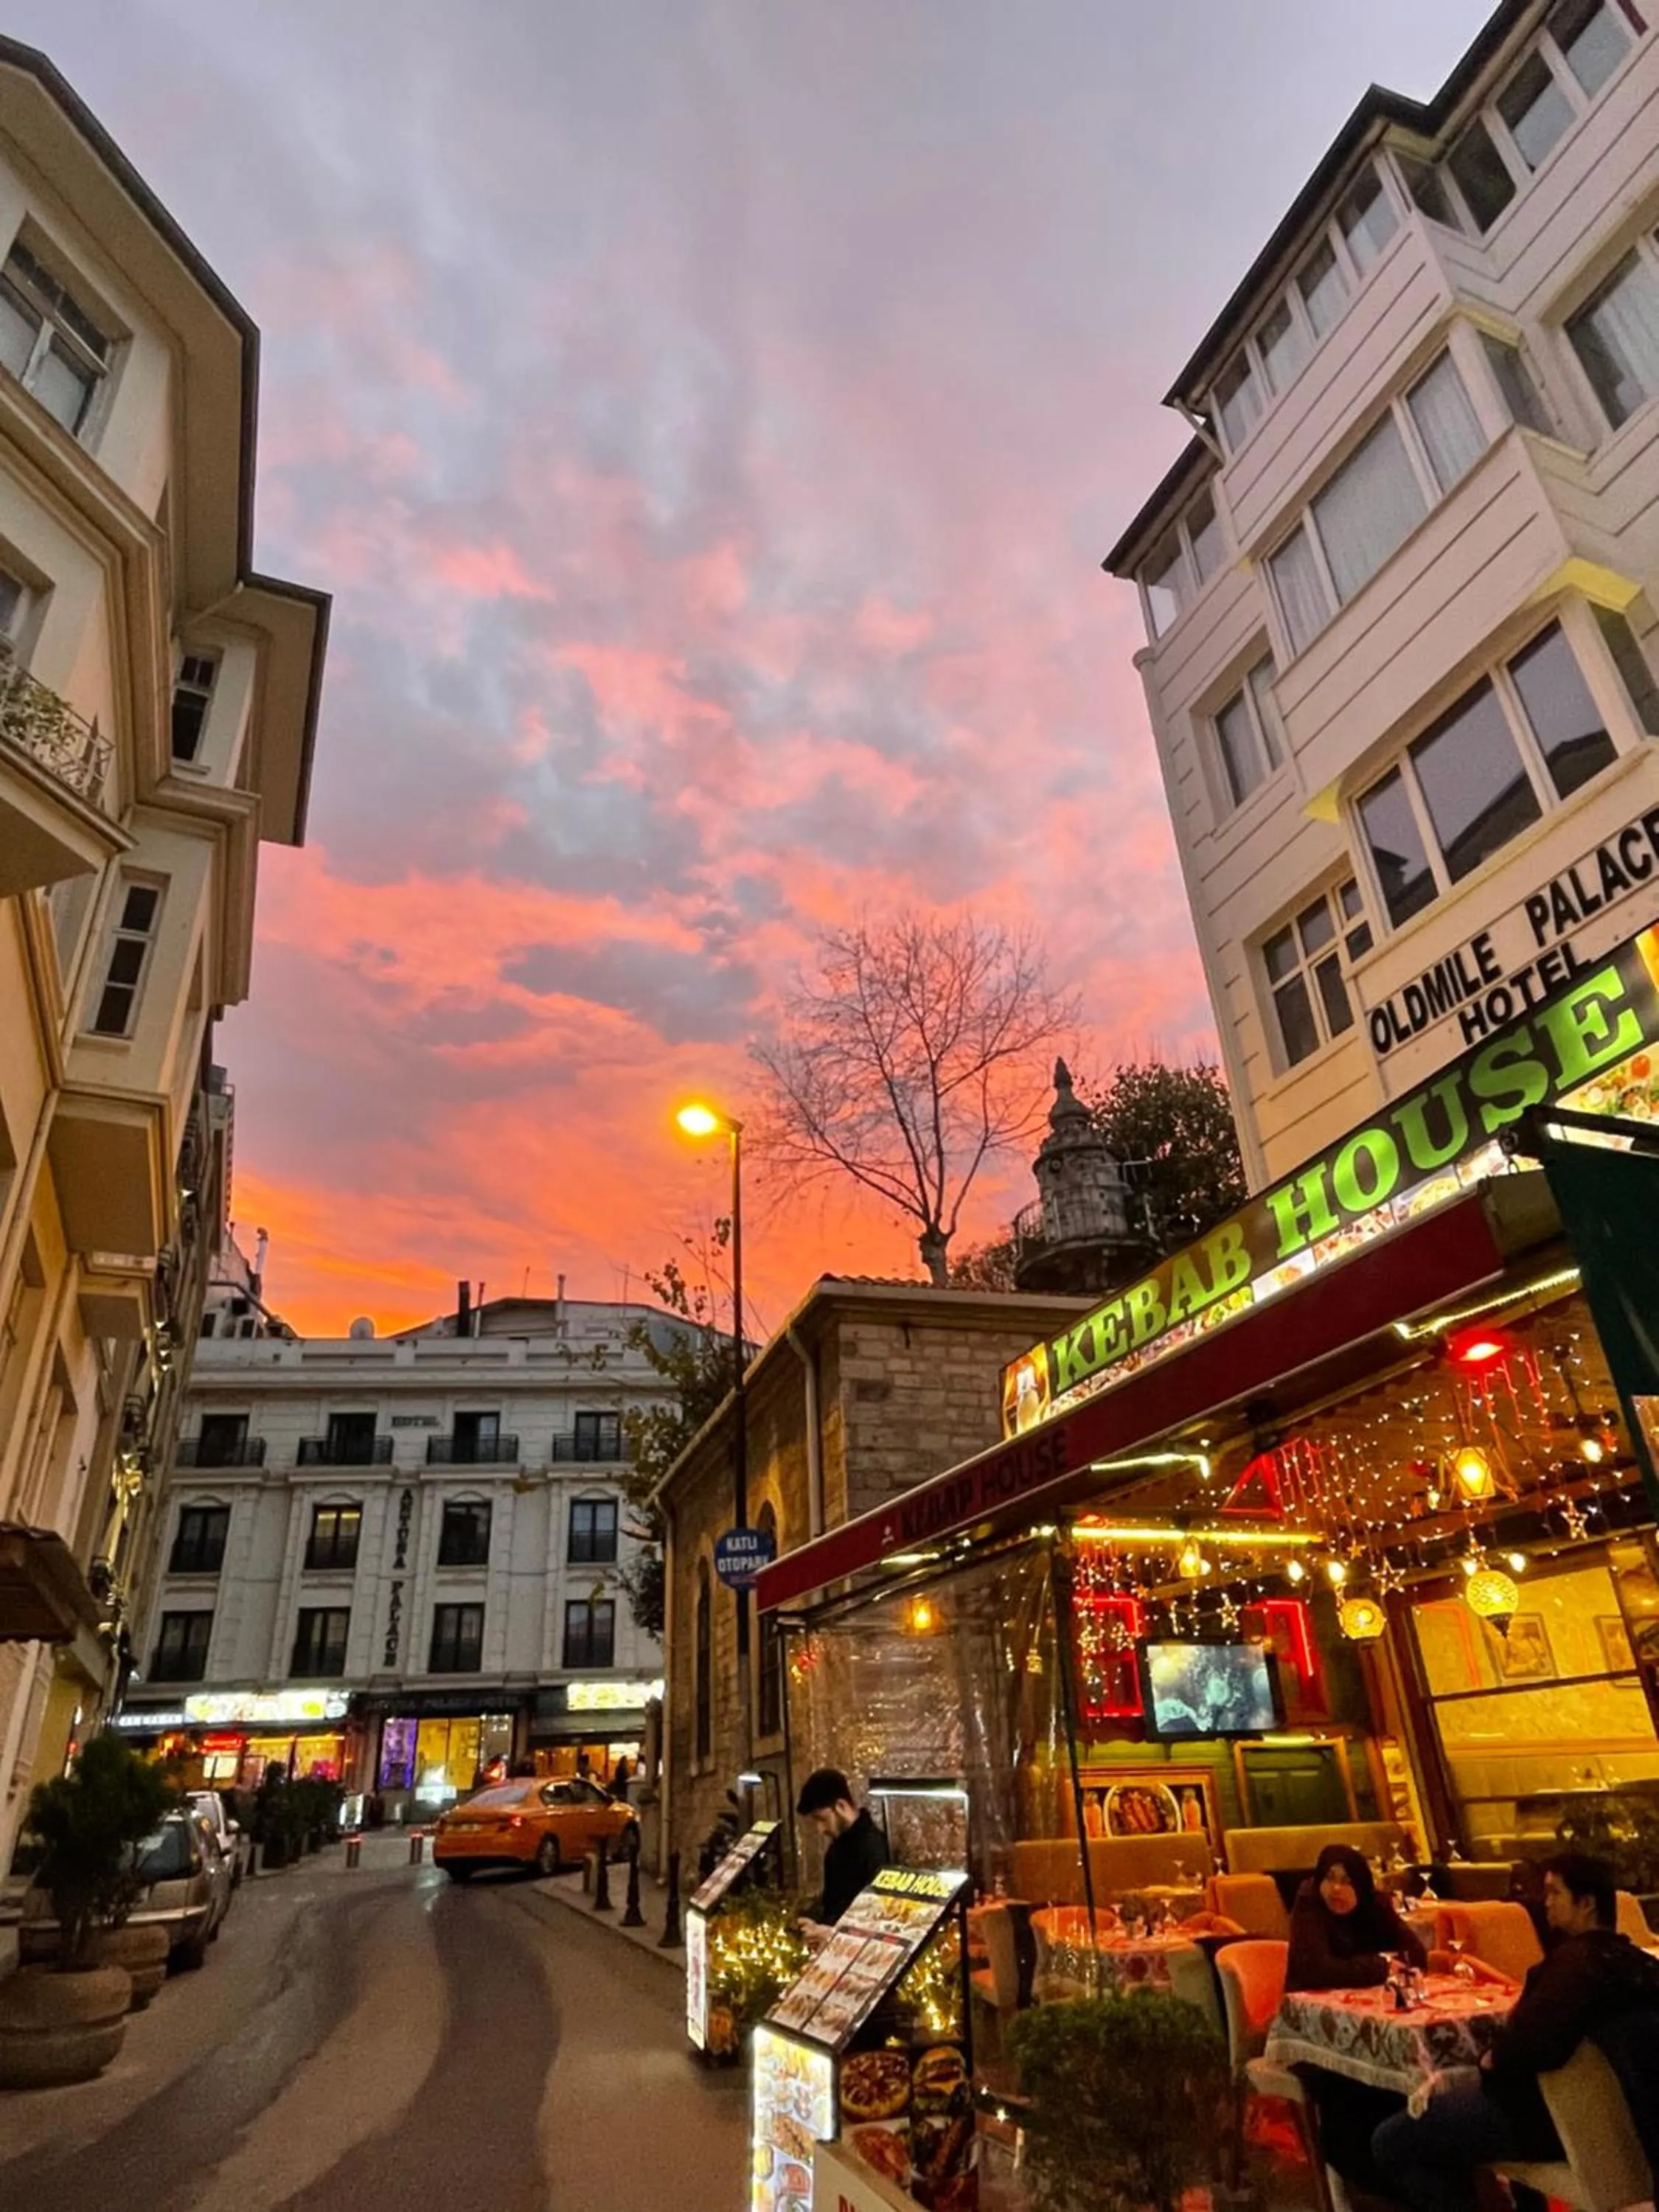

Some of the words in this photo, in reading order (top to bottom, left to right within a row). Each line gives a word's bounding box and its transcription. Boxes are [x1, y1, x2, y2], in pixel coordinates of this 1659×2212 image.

[1369, 932, 1503, 1054] OLDMILE
[1458, 942, 1591, 1045] HOTEL
[1051, 1221, 1252, 1392] KEBAB
[1267, 965, 1645, 1260] HOUSE
[726, 1536, 758, 1551] KATLI
